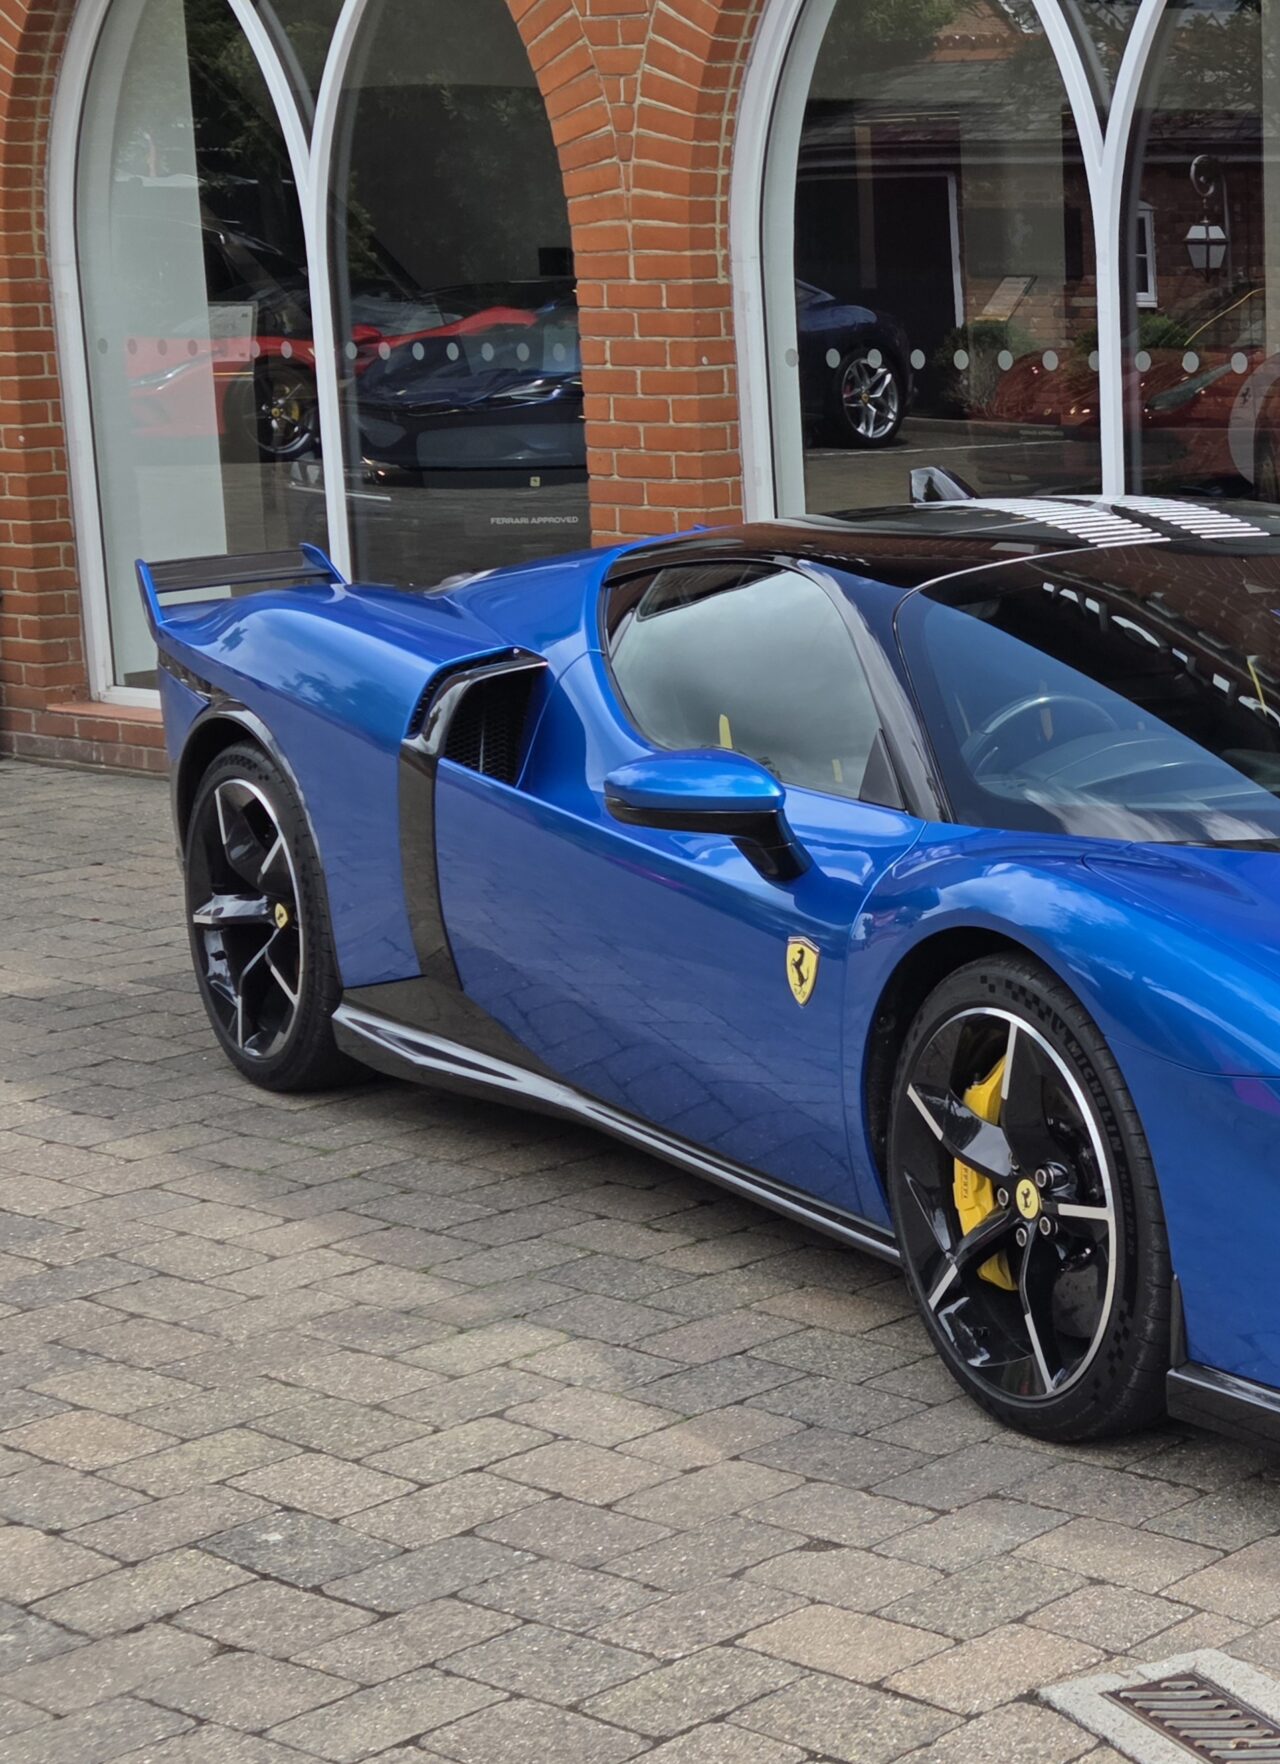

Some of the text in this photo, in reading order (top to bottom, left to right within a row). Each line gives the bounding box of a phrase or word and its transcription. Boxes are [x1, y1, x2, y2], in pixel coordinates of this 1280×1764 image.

[490, 516, 579, 525] FERRARI APPROVED
[1067, 1040, 1123, 1151] MICHELIN
